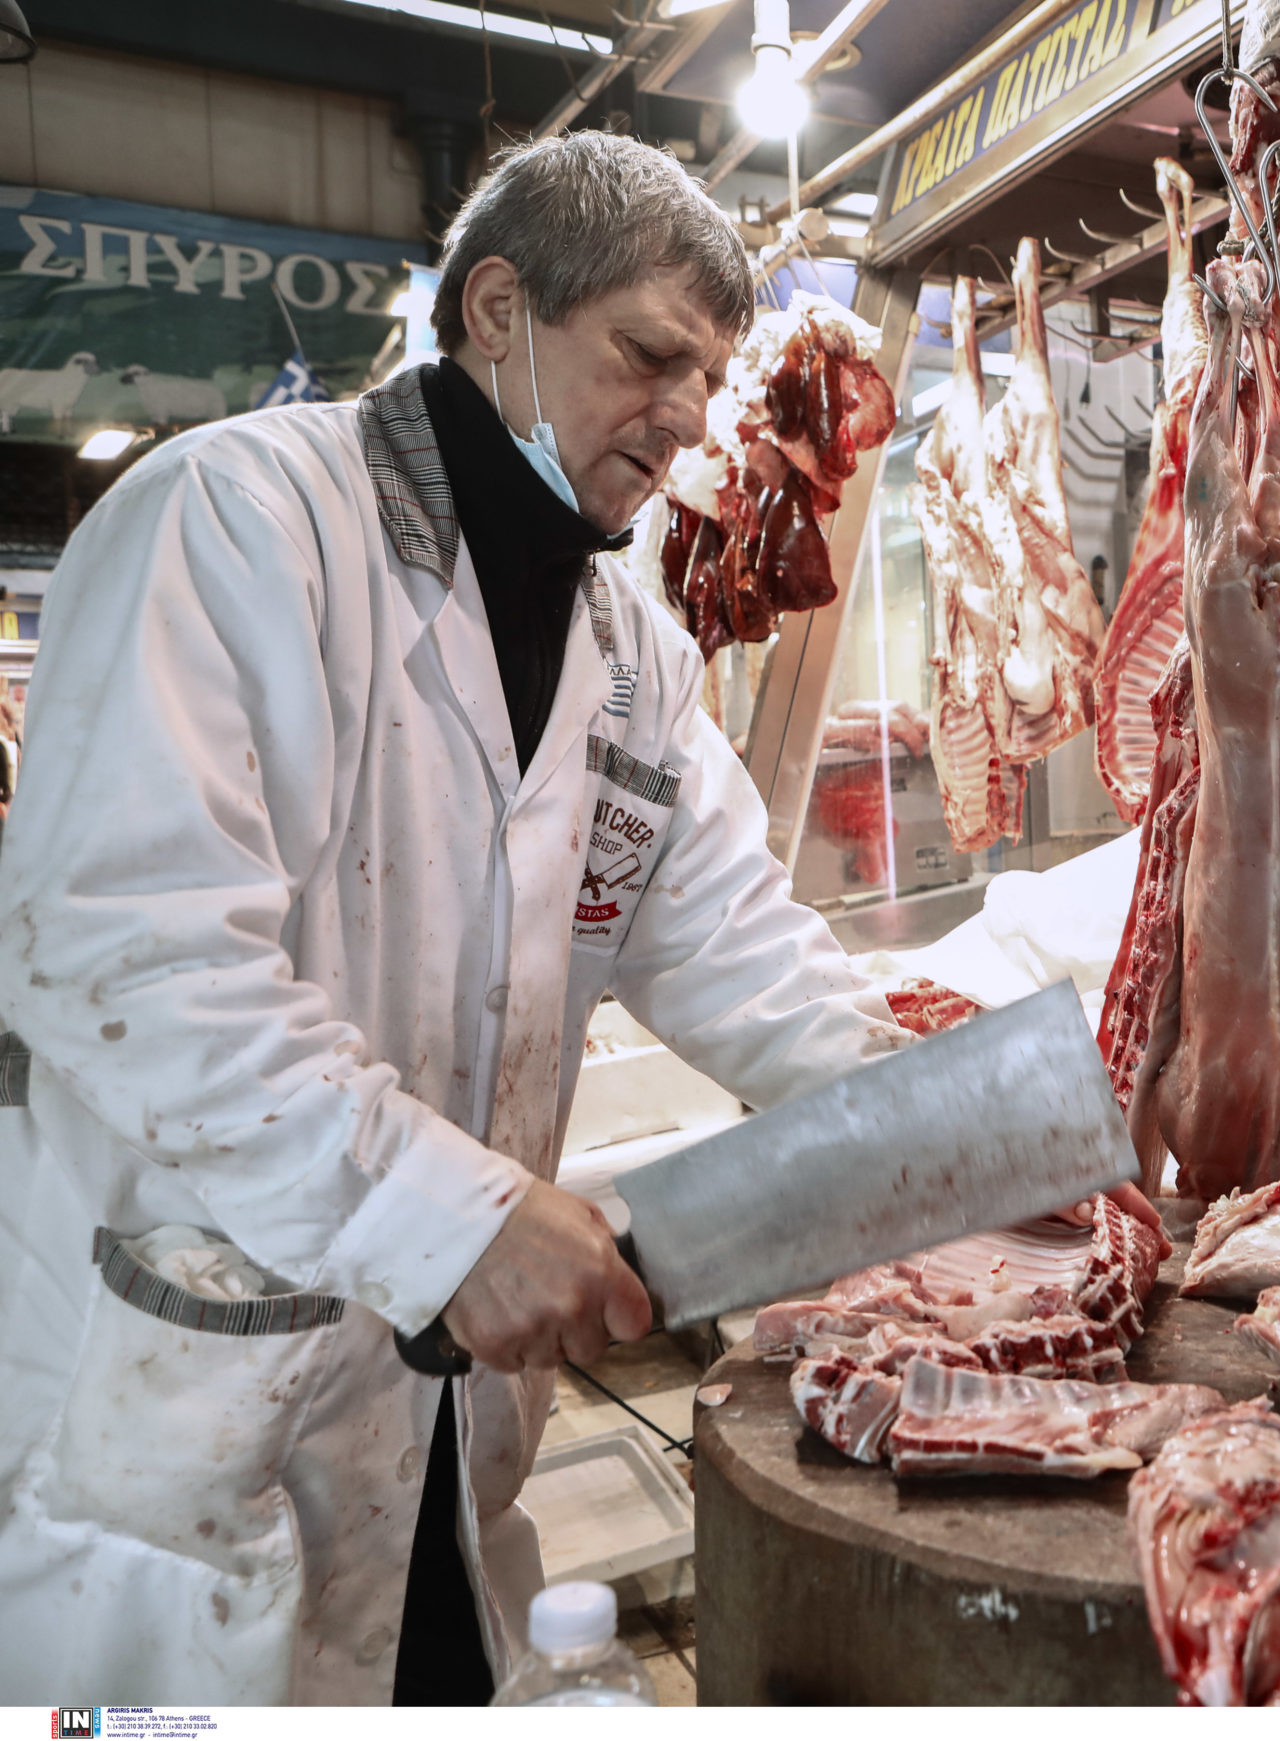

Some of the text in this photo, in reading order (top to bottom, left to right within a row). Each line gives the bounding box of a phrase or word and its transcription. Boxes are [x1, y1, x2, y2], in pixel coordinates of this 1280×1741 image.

[18, 214, 393, 317] ΣΠΥΡΟΣ
[593, 798, 655, 849] UTCHER
[590, 831, 624, 855] SHOP
[577, 907, 610, 918] STAS
[577, 925, 612, 936] quality
